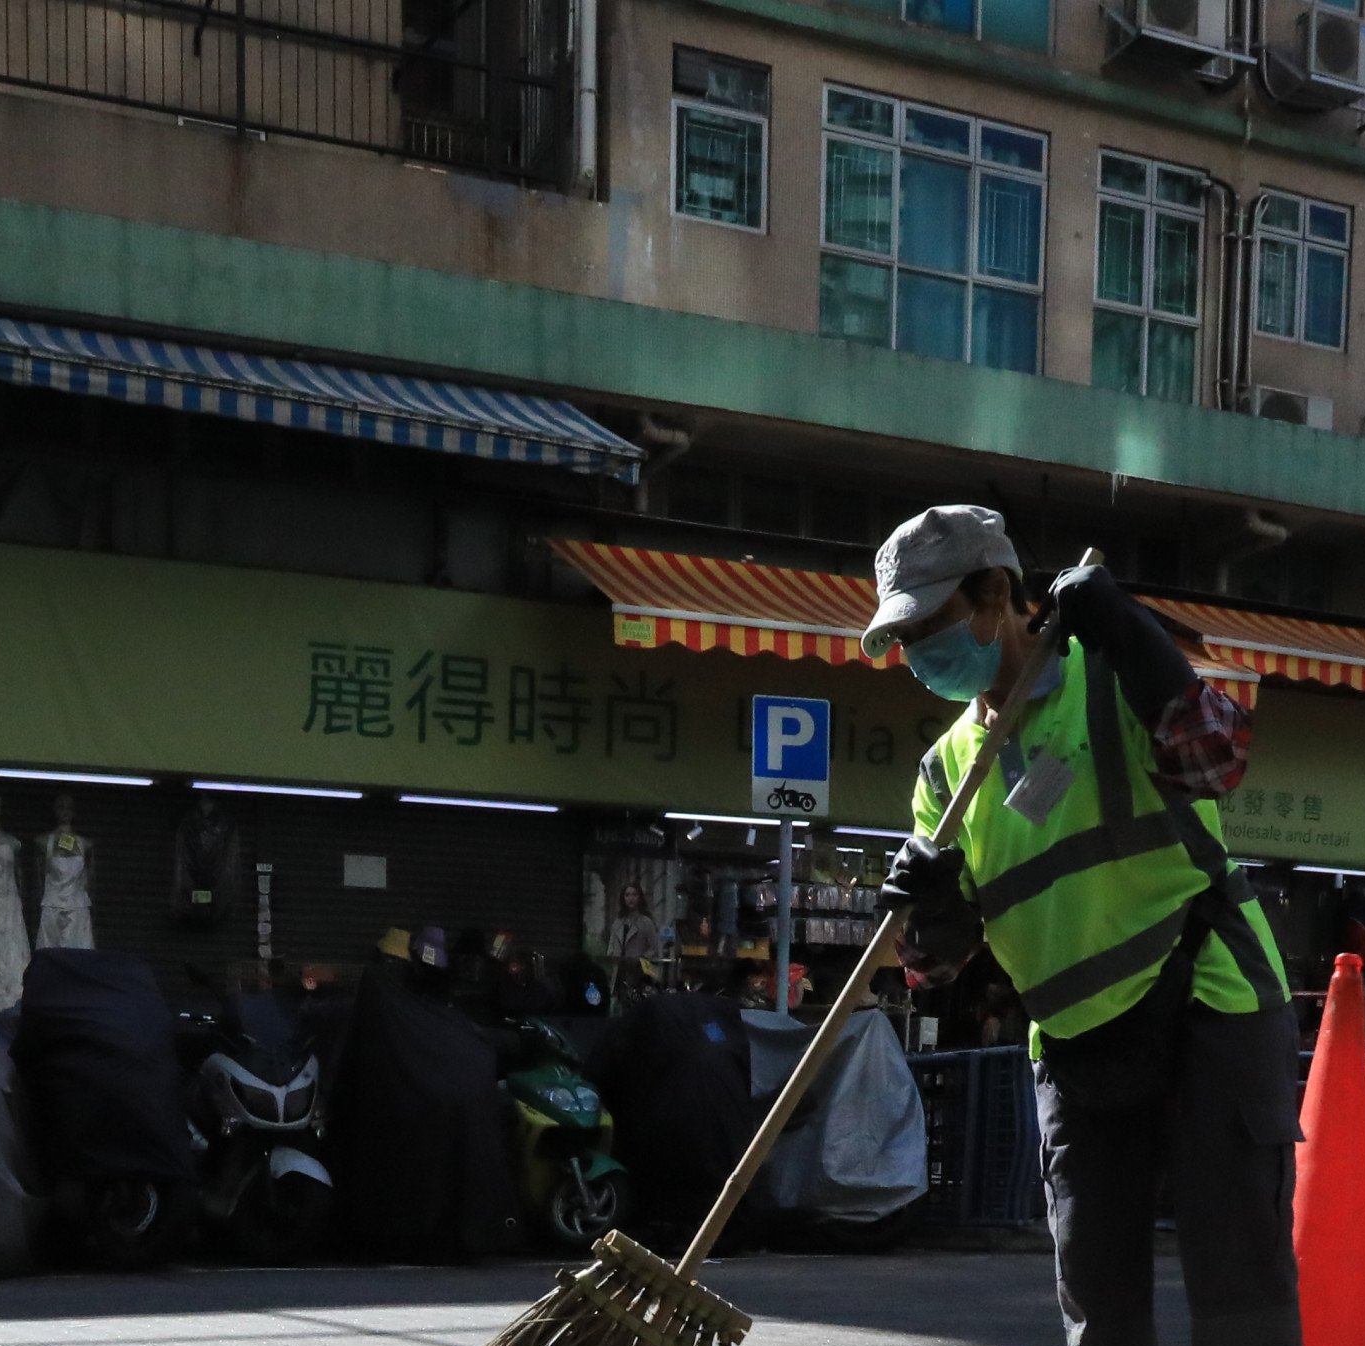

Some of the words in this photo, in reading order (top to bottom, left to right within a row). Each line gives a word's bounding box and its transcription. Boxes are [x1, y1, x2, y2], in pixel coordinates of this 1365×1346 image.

[300, 640, 678, 762] 麗得時尚
[736, 696, 894, 766] Lia
[767, 705, 815, 771] P
[1221, 820, 1282, 841] holesale
[1285, 829, 1311, 844] and
[1316, 832, 1350, 847] retail
